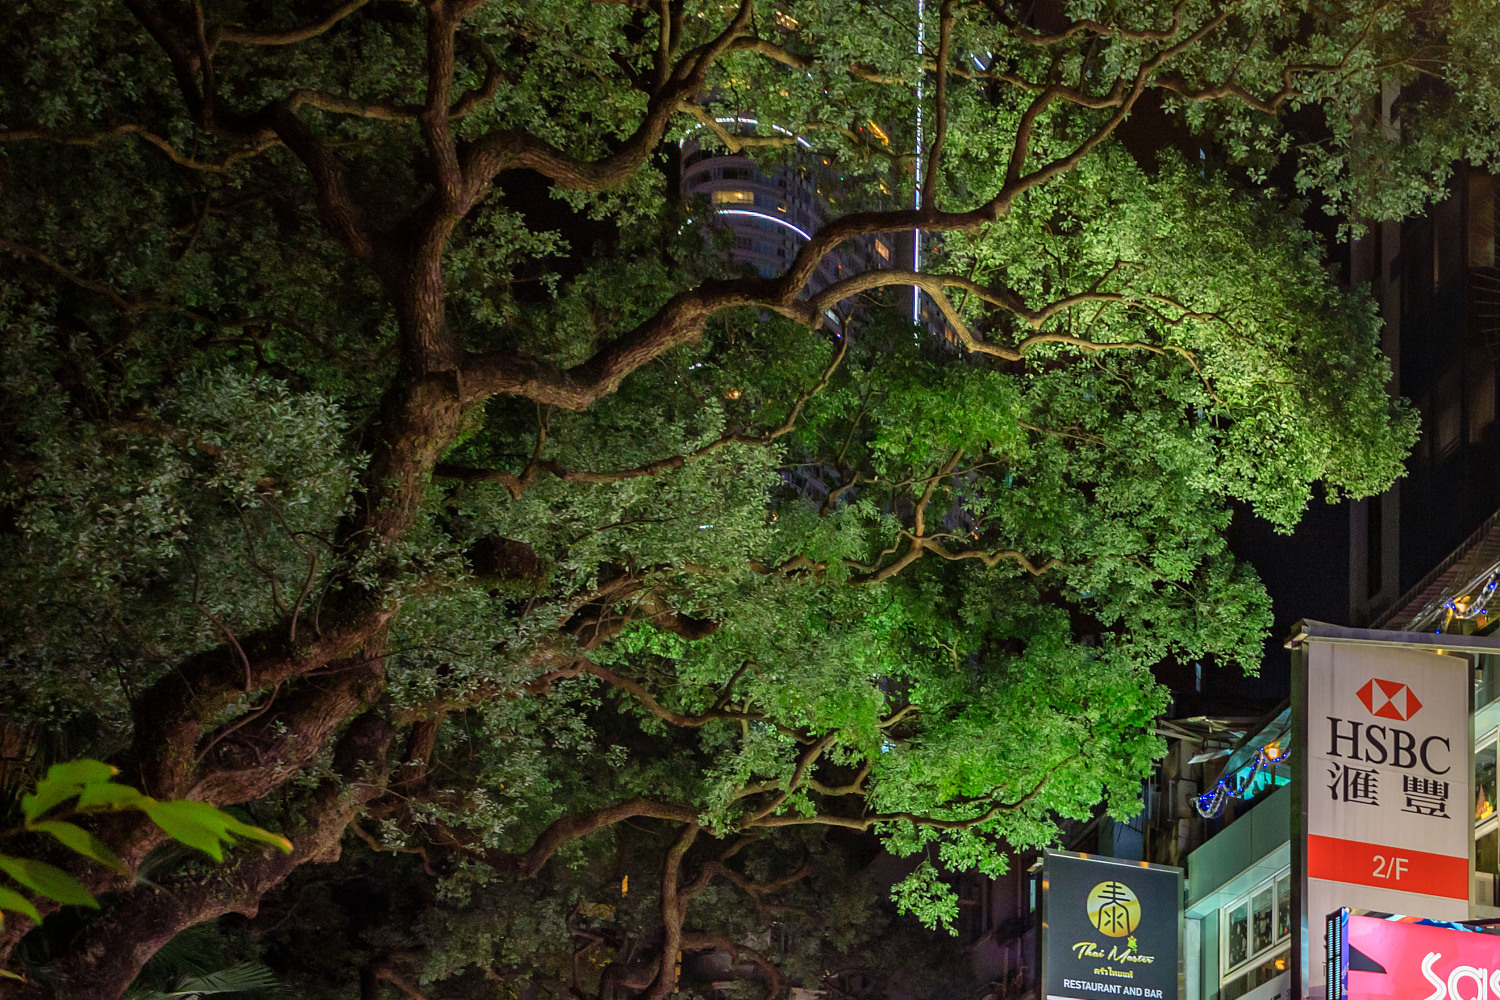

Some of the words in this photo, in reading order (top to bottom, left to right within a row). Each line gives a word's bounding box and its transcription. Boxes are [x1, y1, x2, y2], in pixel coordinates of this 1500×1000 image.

[1326, 717, 1451, 775] HSBC
[1372, 854, 1409, 881] 2/F
[1072, 942, 1105, 960] Thai
[1107, 945, 1155, 964] Master
[1063, 979, 1121, 994] RESTAURANT
[1123, 986, 1143, 996] AND
[1144, 988, 1163, 999] BAR
